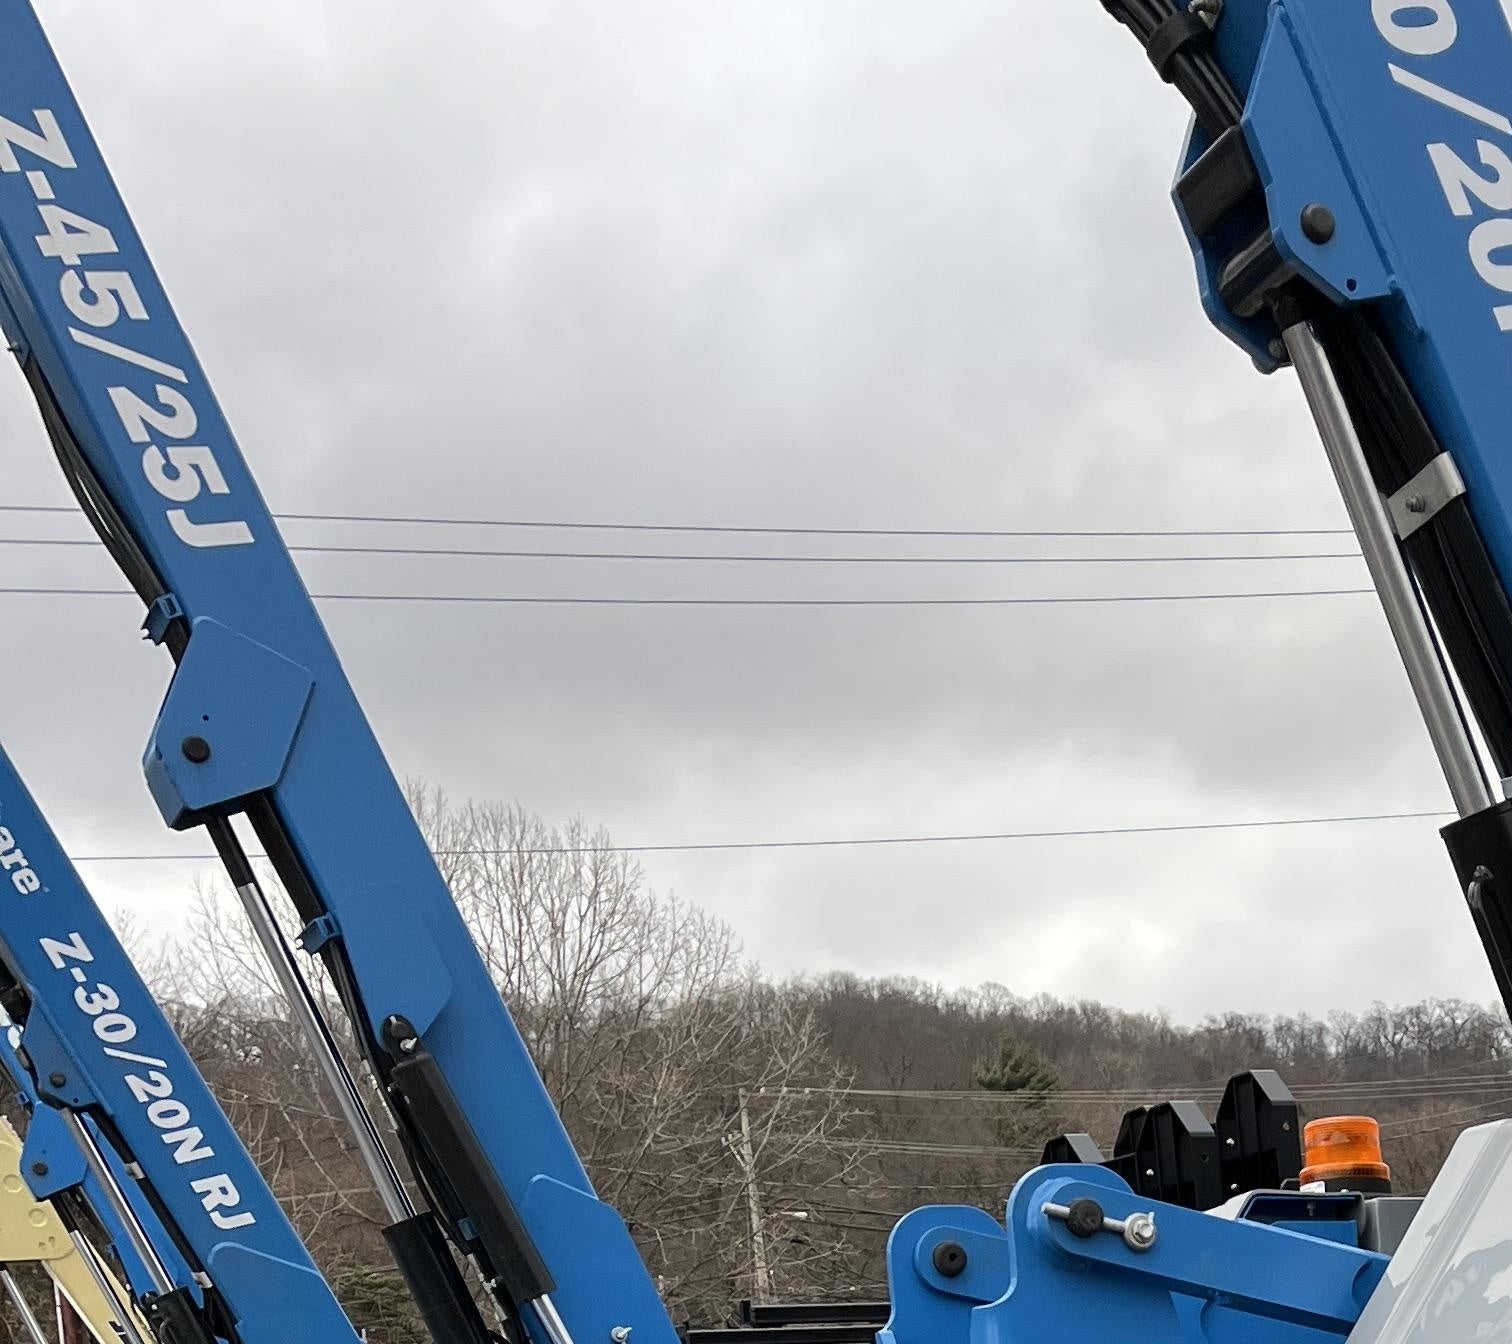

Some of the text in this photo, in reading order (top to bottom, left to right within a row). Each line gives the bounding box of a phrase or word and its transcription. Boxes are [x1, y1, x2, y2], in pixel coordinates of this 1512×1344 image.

[0, 108, 255, 548] Z-45/25J
[39, 932, 256, 1230] Z-30/20N RJ
